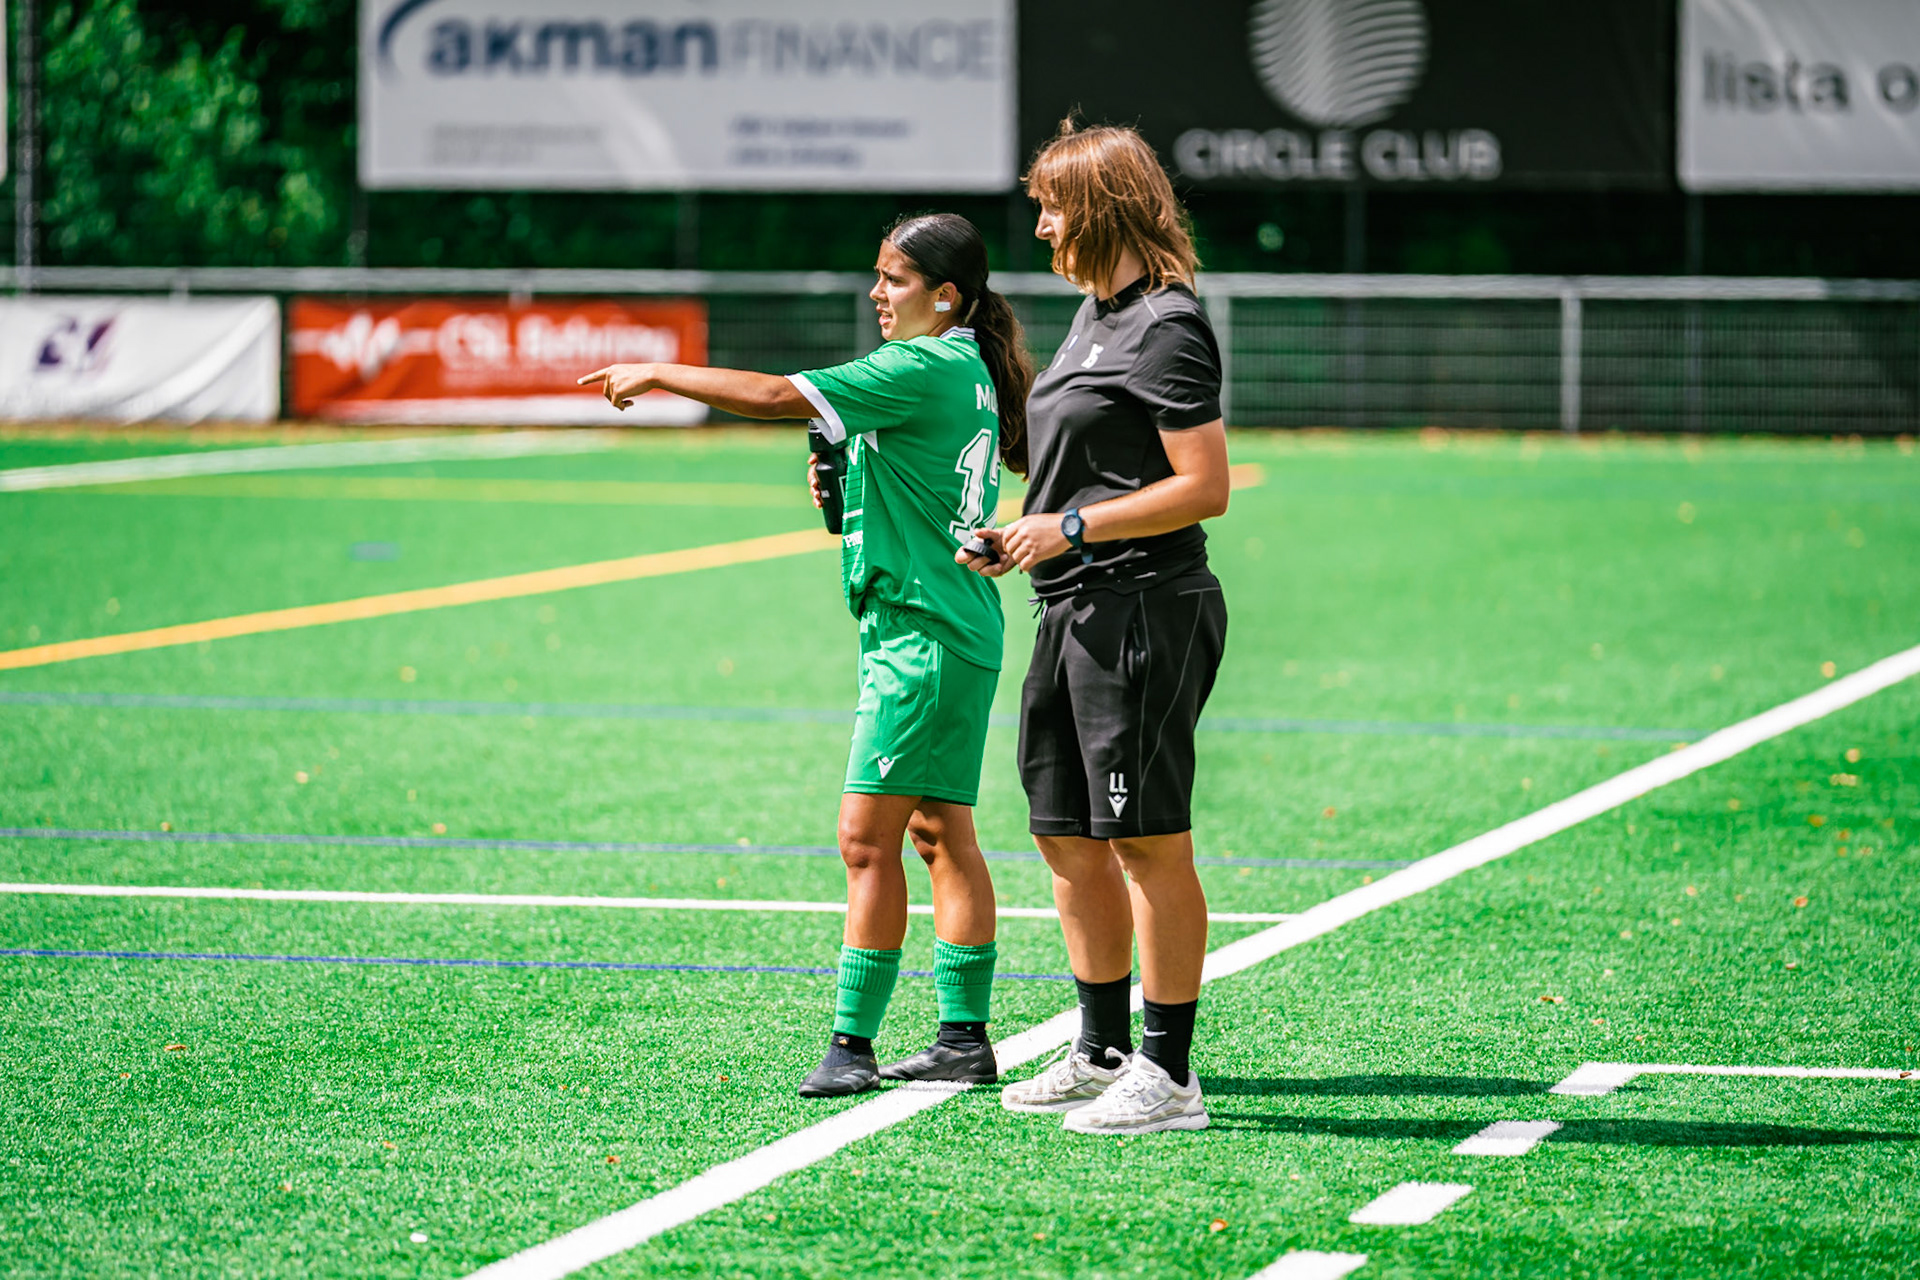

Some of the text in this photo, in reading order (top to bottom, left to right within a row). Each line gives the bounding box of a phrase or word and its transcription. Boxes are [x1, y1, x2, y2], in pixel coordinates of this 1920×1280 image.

[428, 19, 1000, 78] akman FINANCE
[1703, 50, 1849, 112] lista
[1173, 128, 1502, 180] CIRCLE CLUB
[439, 314, 510, 366] CSL
[1109, 772, 1128, 793] LL
